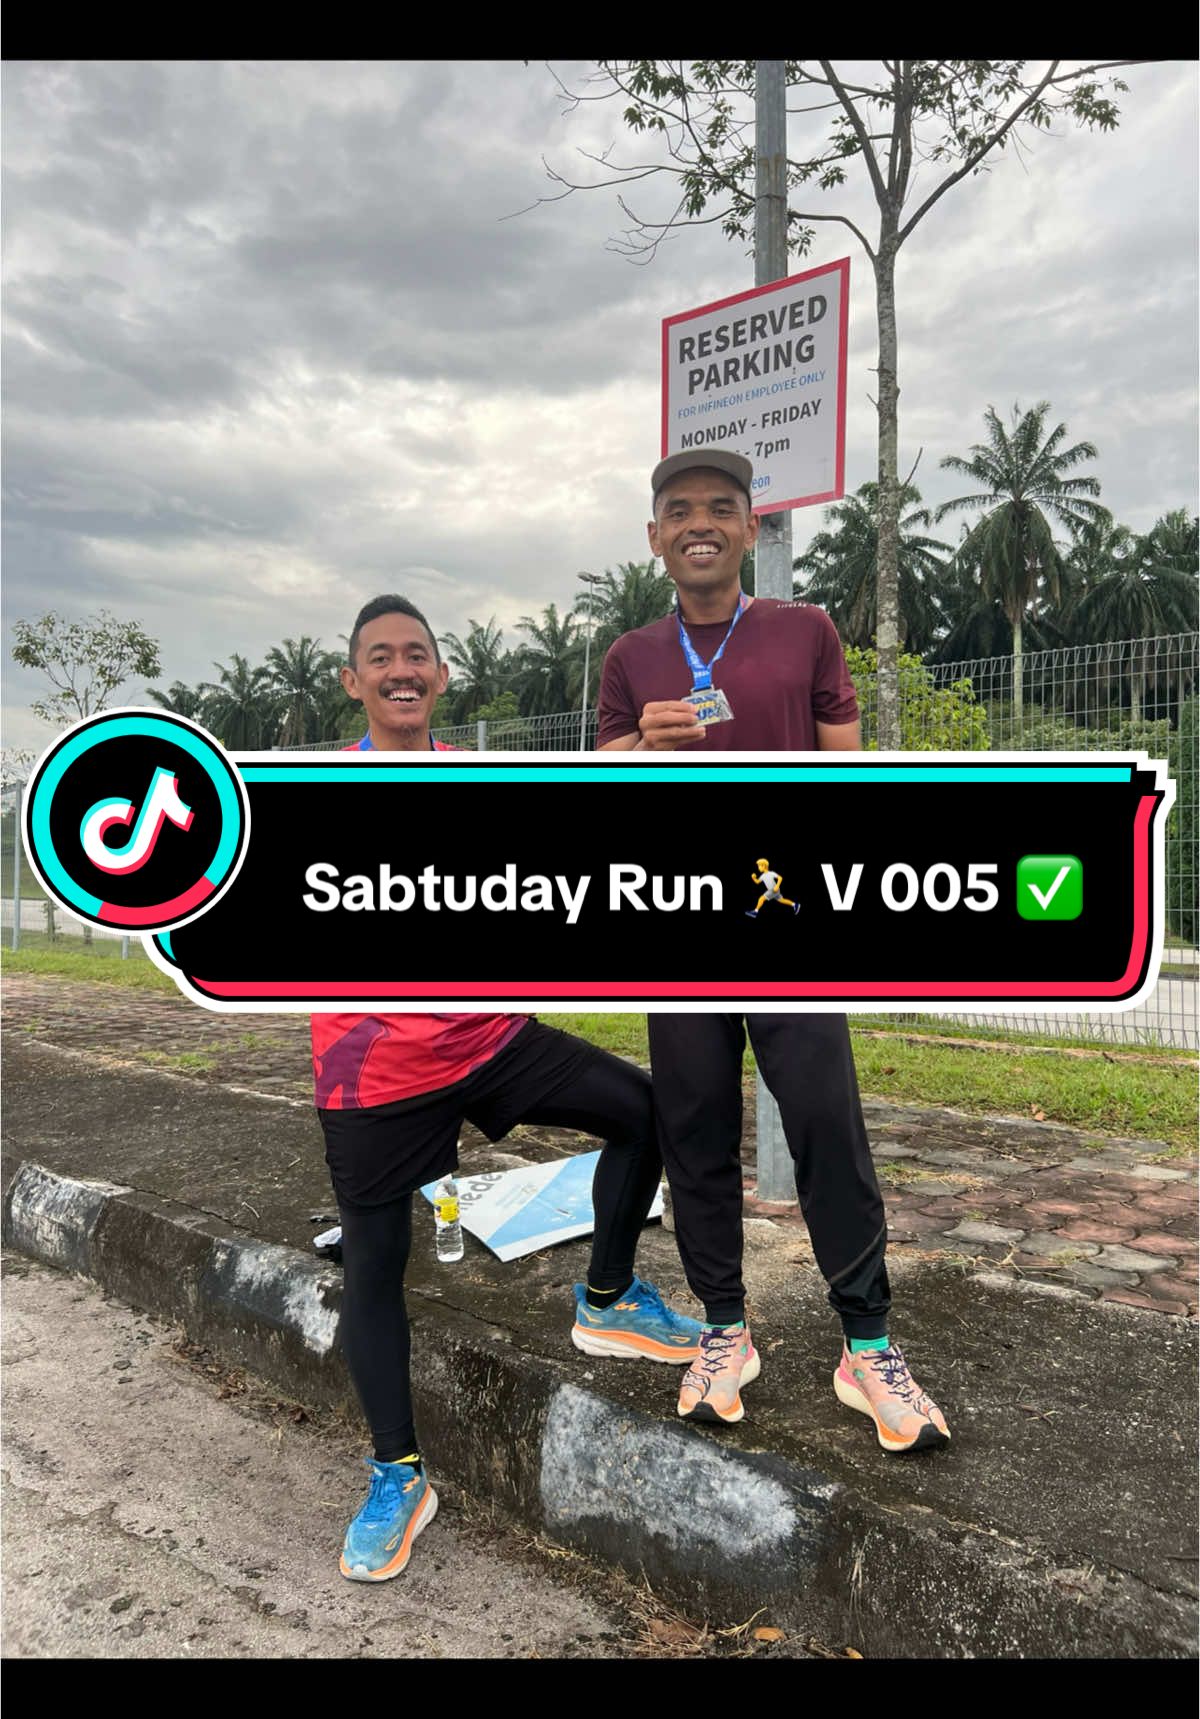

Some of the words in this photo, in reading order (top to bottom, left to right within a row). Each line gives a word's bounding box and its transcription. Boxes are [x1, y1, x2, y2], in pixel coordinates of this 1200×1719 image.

[679, 295, 827, 364] RESERVED
[688, 334, 815, 396] PARKING
[678, 405, 696, 419] FOR
[698, 393, 743, 414] INFINEON
[745, 378, 797, 401] EMPLOYEE
[800, 369, 826, 387] ONLY
[681, 418, 747, 449] MONDAY
[761, 398, 822, 429] FRIDAY
[754, 437, 790, 459] 7pm
